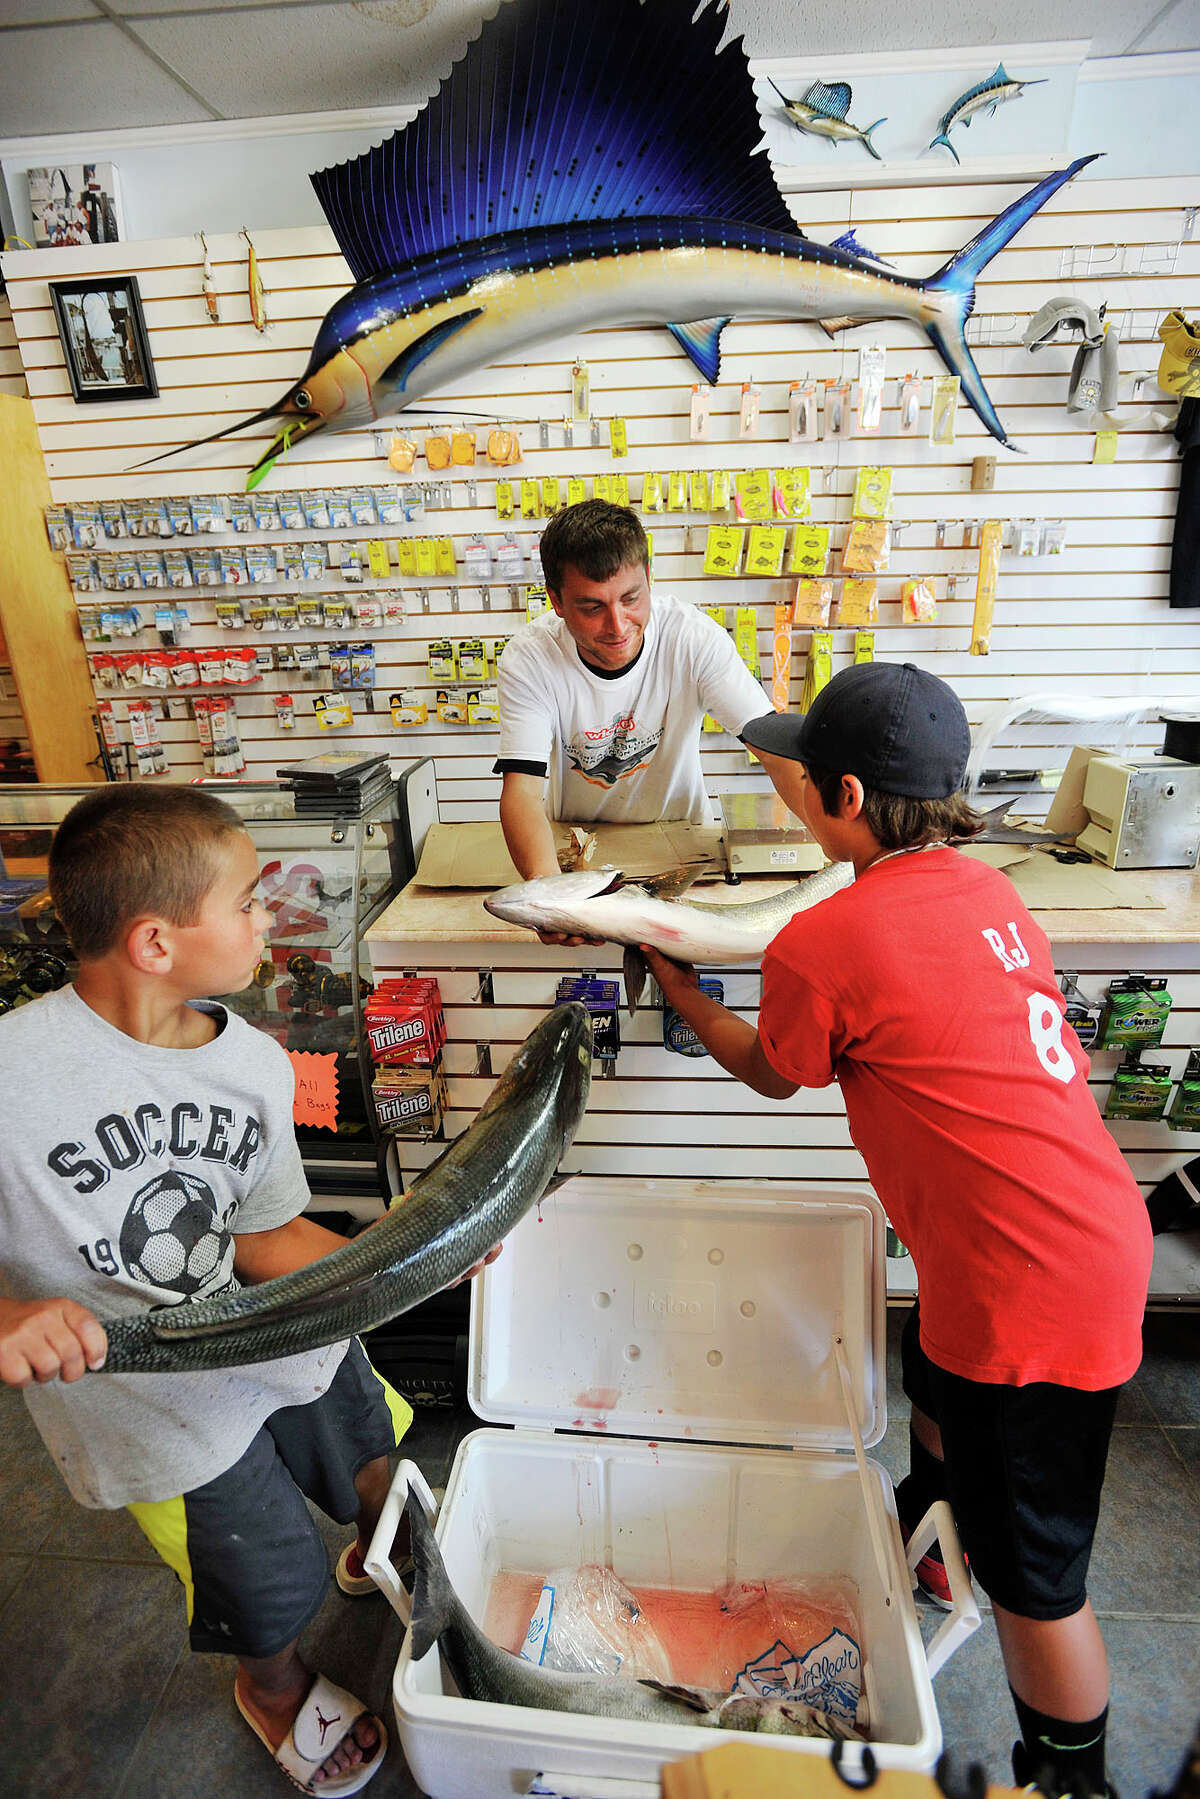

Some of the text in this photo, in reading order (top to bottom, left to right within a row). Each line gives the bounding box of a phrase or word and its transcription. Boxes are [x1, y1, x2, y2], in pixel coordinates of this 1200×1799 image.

[981, 922, 1030, 972] RJ
[370, 1020, 424, 1050] Trilene
[673, 1031, 699, 1043] Trile
[1026, 992, 1077, 1083] 8
[299, 1079, 318, 1093] All
[306, 1097, 331, 1112] Bags
[378, 1095, 428, 1121] Trilene
[48, 1102, 260, 1194] SOCCER
[78, 1238, 120, 1276] 19
